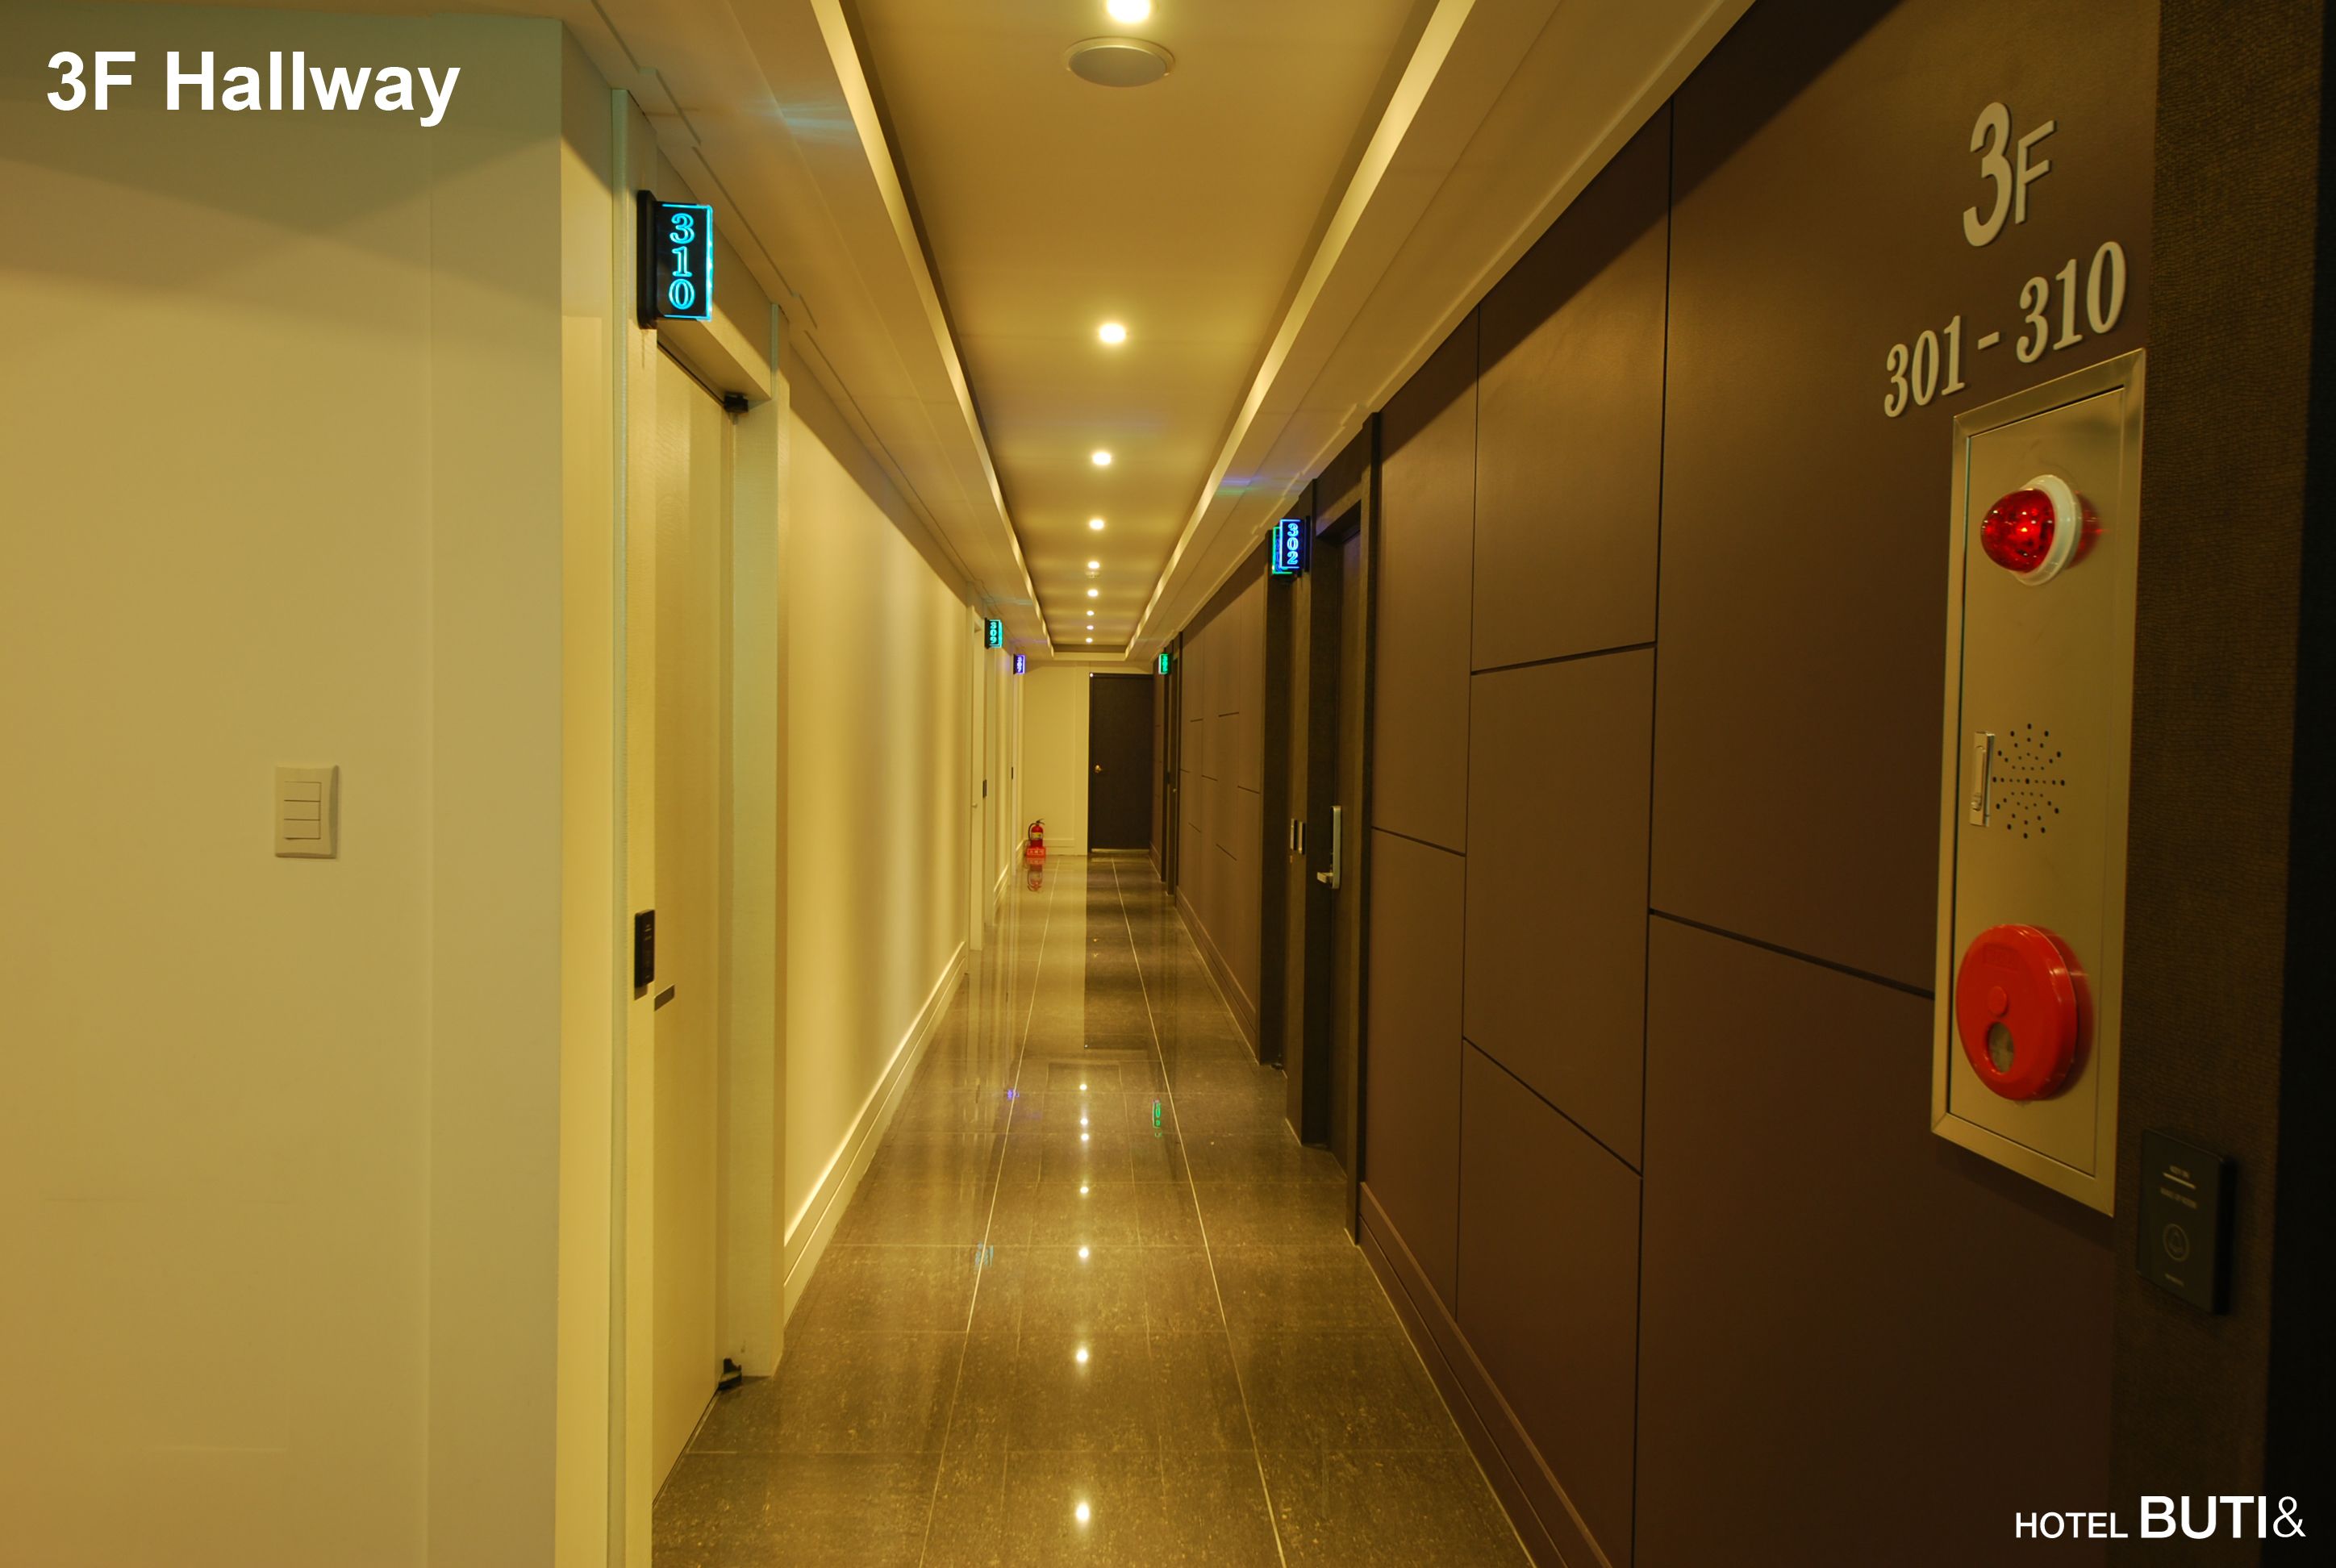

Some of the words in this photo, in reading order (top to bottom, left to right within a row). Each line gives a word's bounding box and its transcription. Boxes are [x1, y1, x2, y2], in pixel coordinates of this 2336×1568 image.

[1963, 102, 2056, 247] 3F
[669, 213, 695, 310] 310
[1883, 315, 1966, 418] 301
[2016, 241, 2127, 364] 310
[1287, 523, 1299, 565] 302
